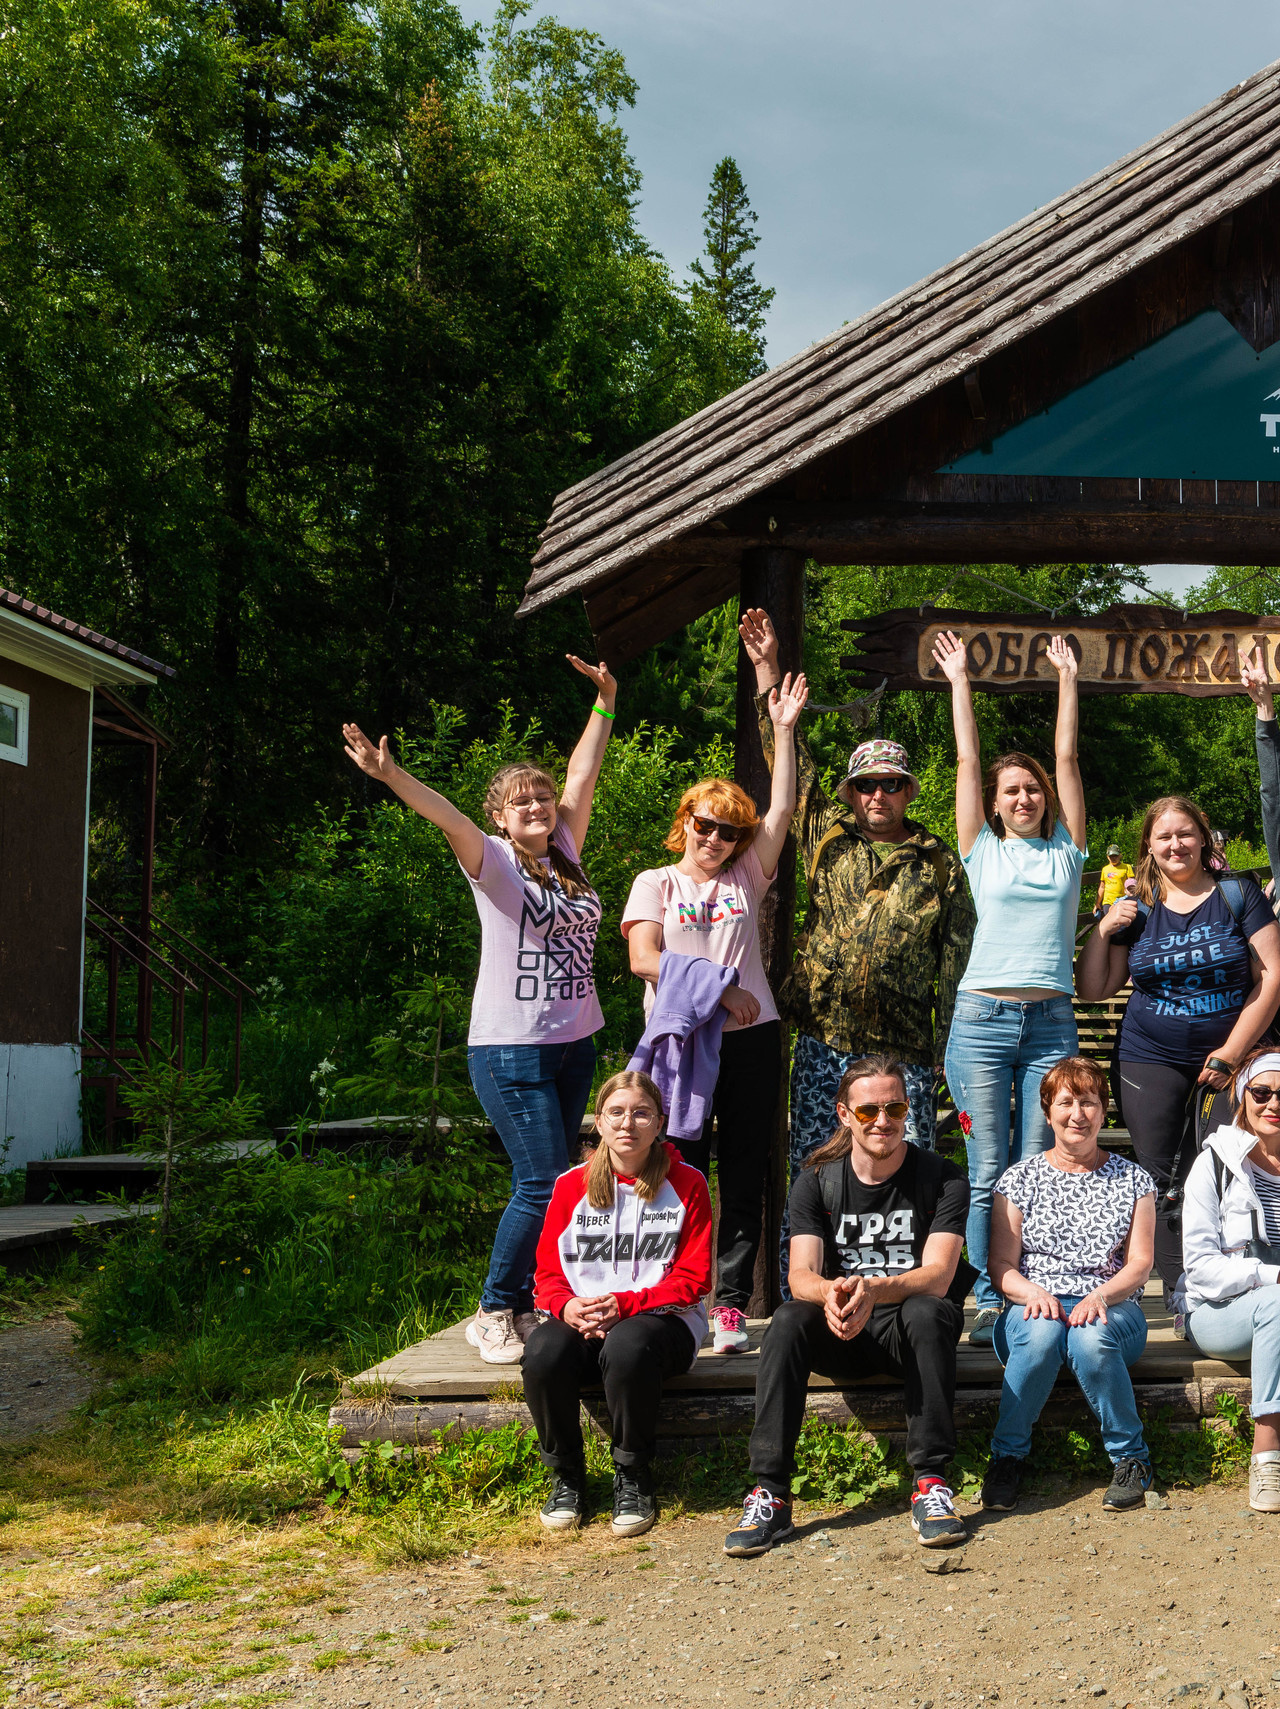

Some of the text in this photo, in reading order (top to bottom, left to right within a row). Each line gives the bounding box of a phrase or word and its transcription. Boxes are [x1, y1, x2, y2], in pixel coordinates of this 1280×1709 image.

[678, 897, 743, 924] NICE
[1160, 925, 1212, 950] JUST
[1153, 943, 1224, 975] HERE
[1160, 969, 1227, 998] FOR
[1153, 989, 1243, 1016] TRAINING
[576, 1214, 611, 1228] BIEBER
[835, 1209, 915, 1245] ГРЯ
